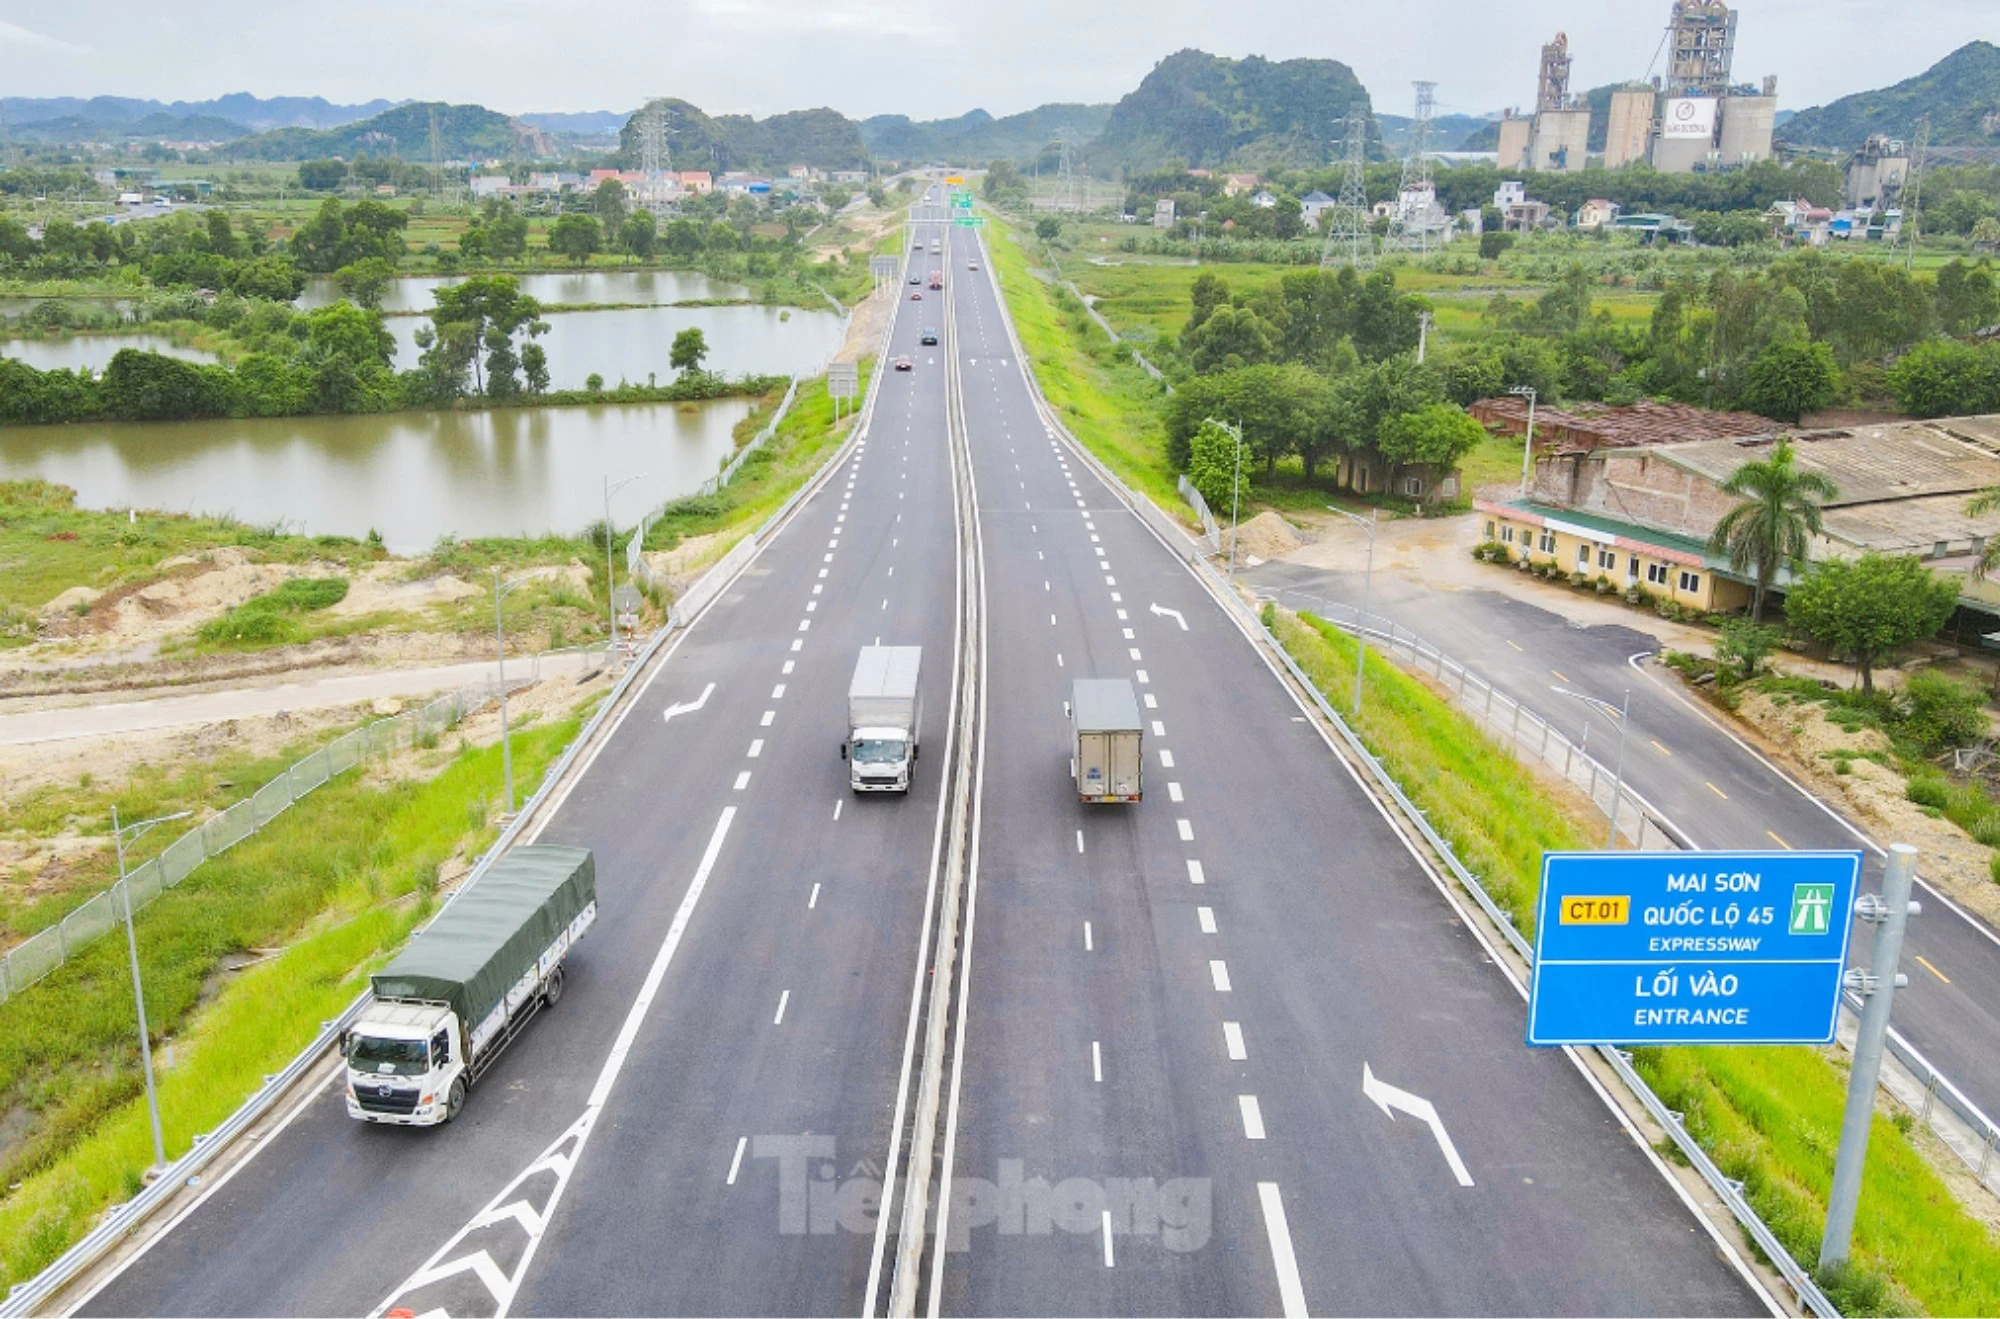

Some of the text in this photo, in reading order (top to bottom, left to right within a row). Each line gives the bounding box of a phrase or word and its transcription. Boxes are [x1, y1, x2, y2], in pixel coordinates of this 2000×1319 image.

[1666, 871, 1761, 893] MAI SƠN
[1570, 902, 1620, 920] CT.01
[1644, 899, 1774, 929] QUỐC LỘ 45
[1649, 937, 1761, 952] EXPRESSWAY
[1635, 967, 1739, 997] LỐI VÀO
[1634, 1008, 1750, 1026] ENTRANCE
